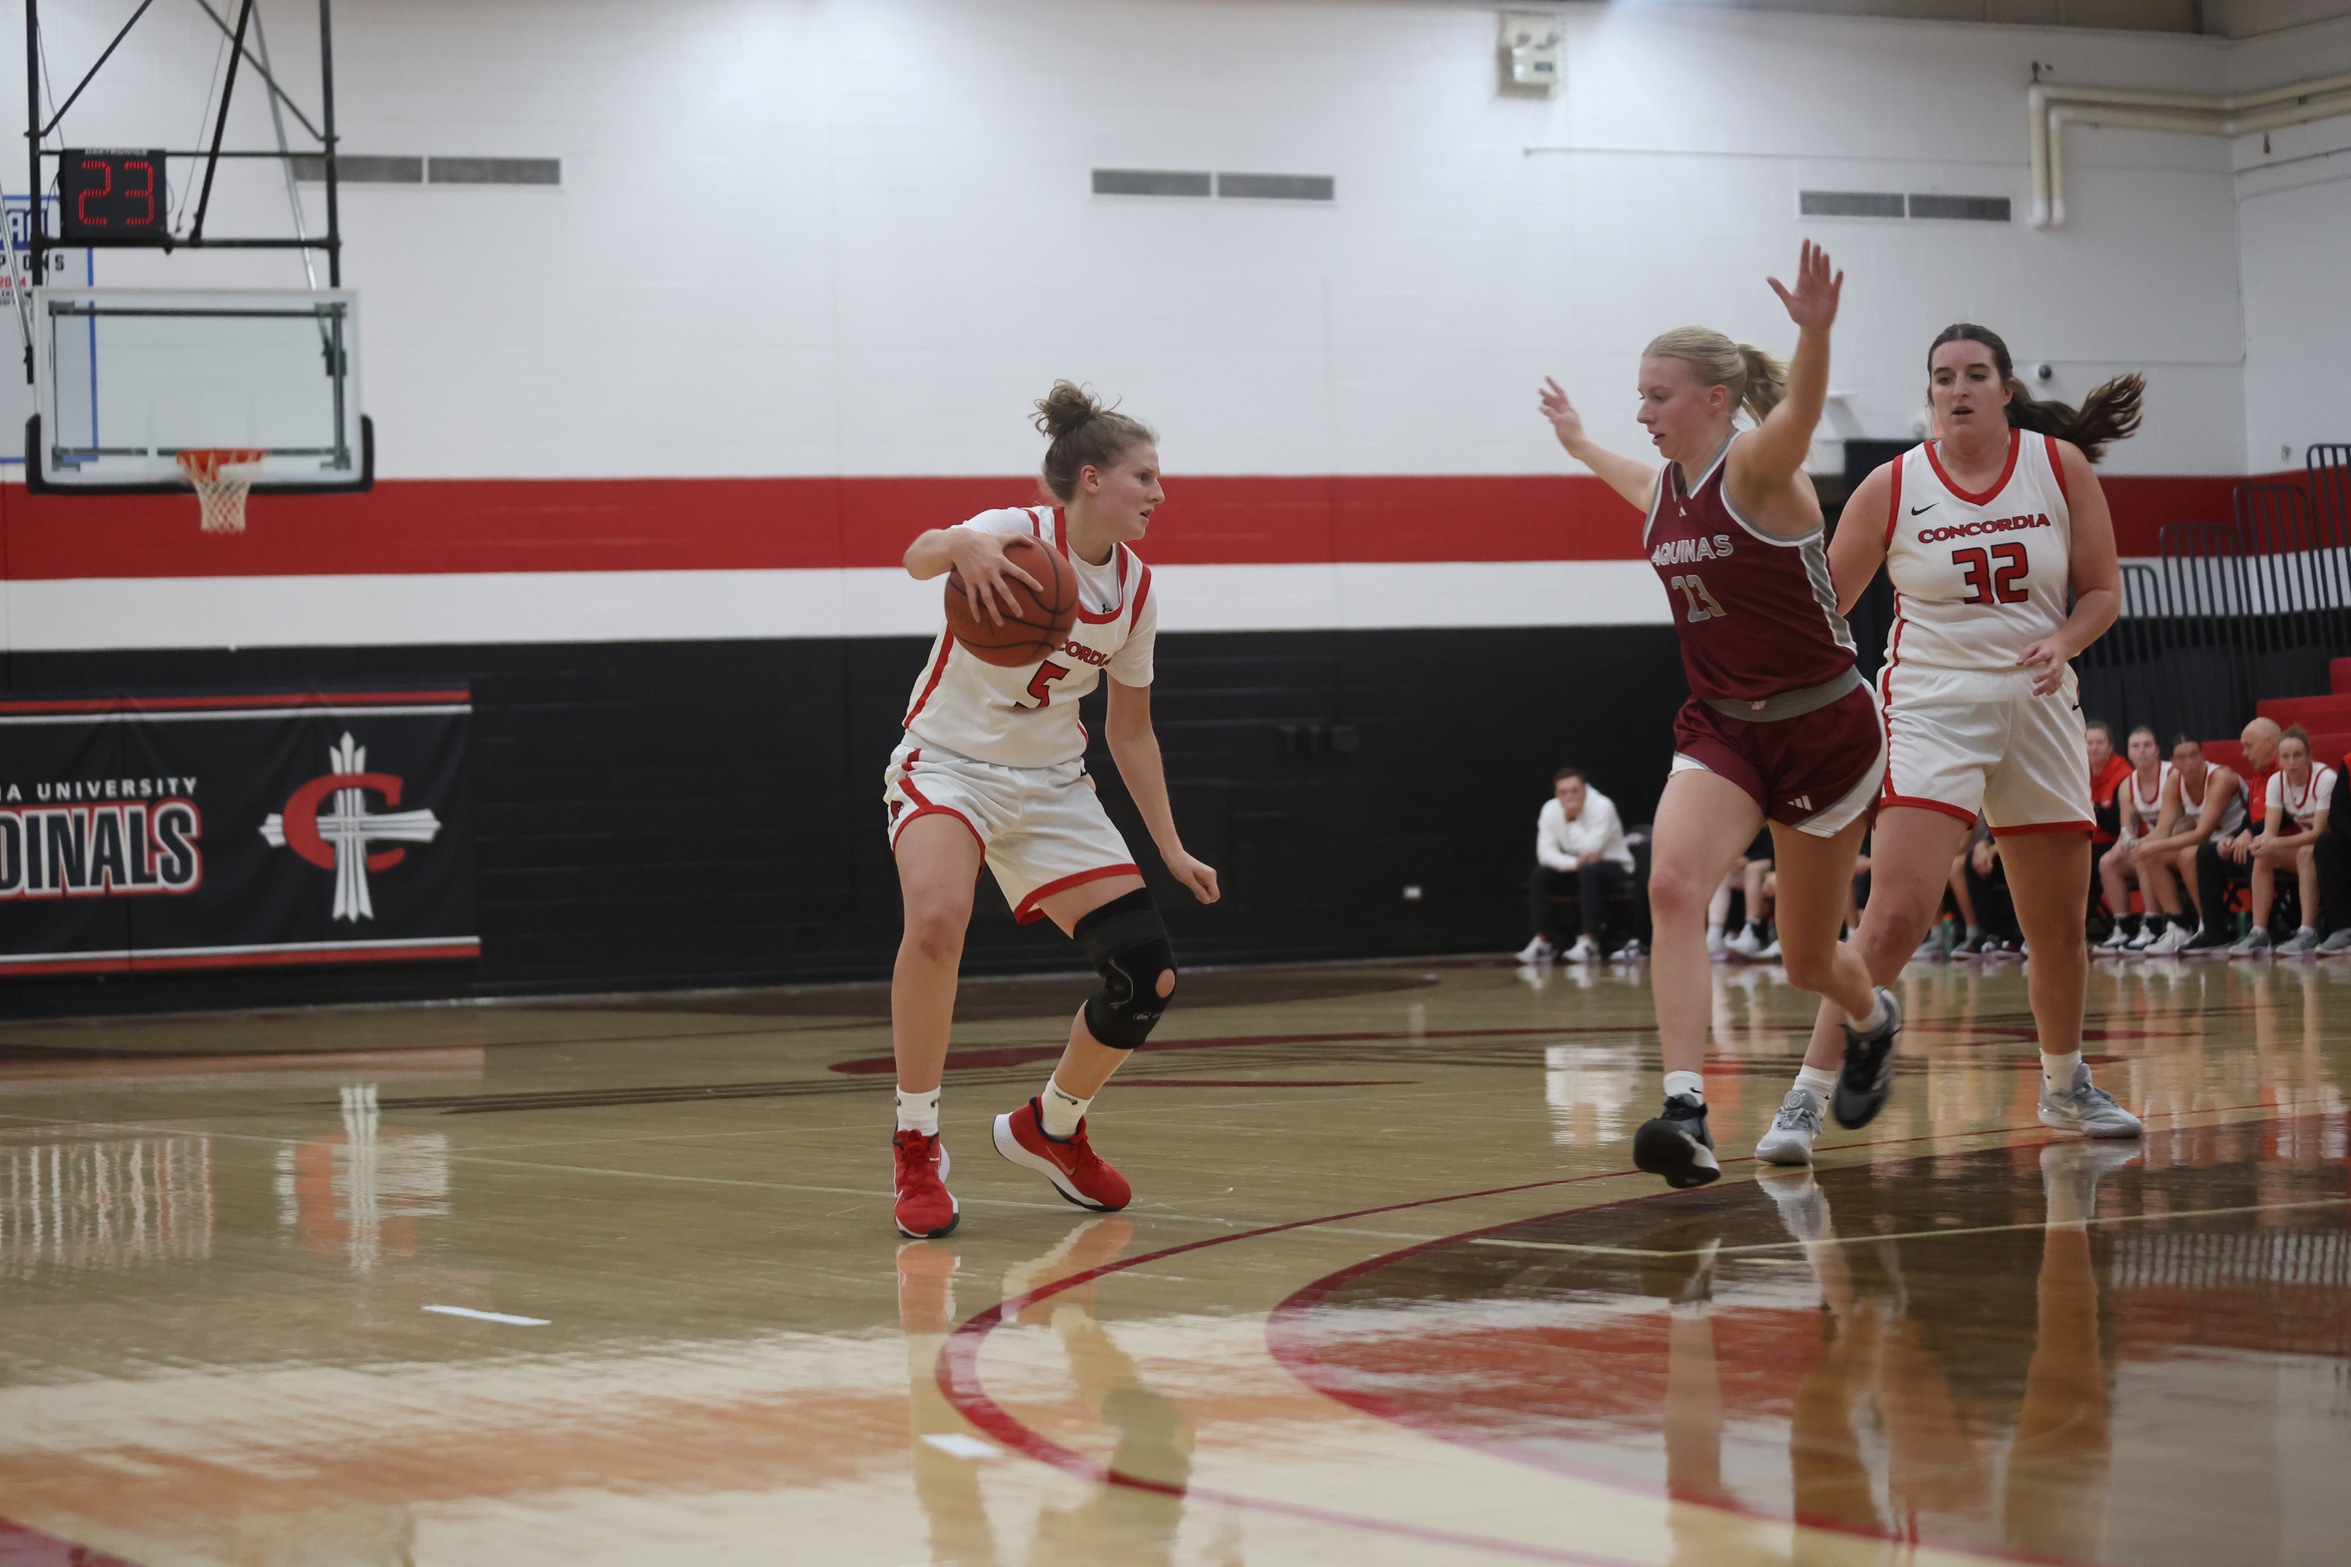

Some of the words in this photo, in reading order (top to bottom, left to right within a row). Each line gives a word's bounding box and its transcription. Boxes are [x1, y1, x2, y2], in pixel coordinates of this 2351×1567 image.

[79, 161, 154, 225] 23
[1651, 534, 1734, 567] AQUINAS
[1918, 513, 2051, 544] CONCORDIA
[1951, 541, 2029, 605] 32
[1671, 574, 1727, 622] 23
[1014, 659, 1071, 709] 5
[37, 777, 197, 800] UNIVERSITY
